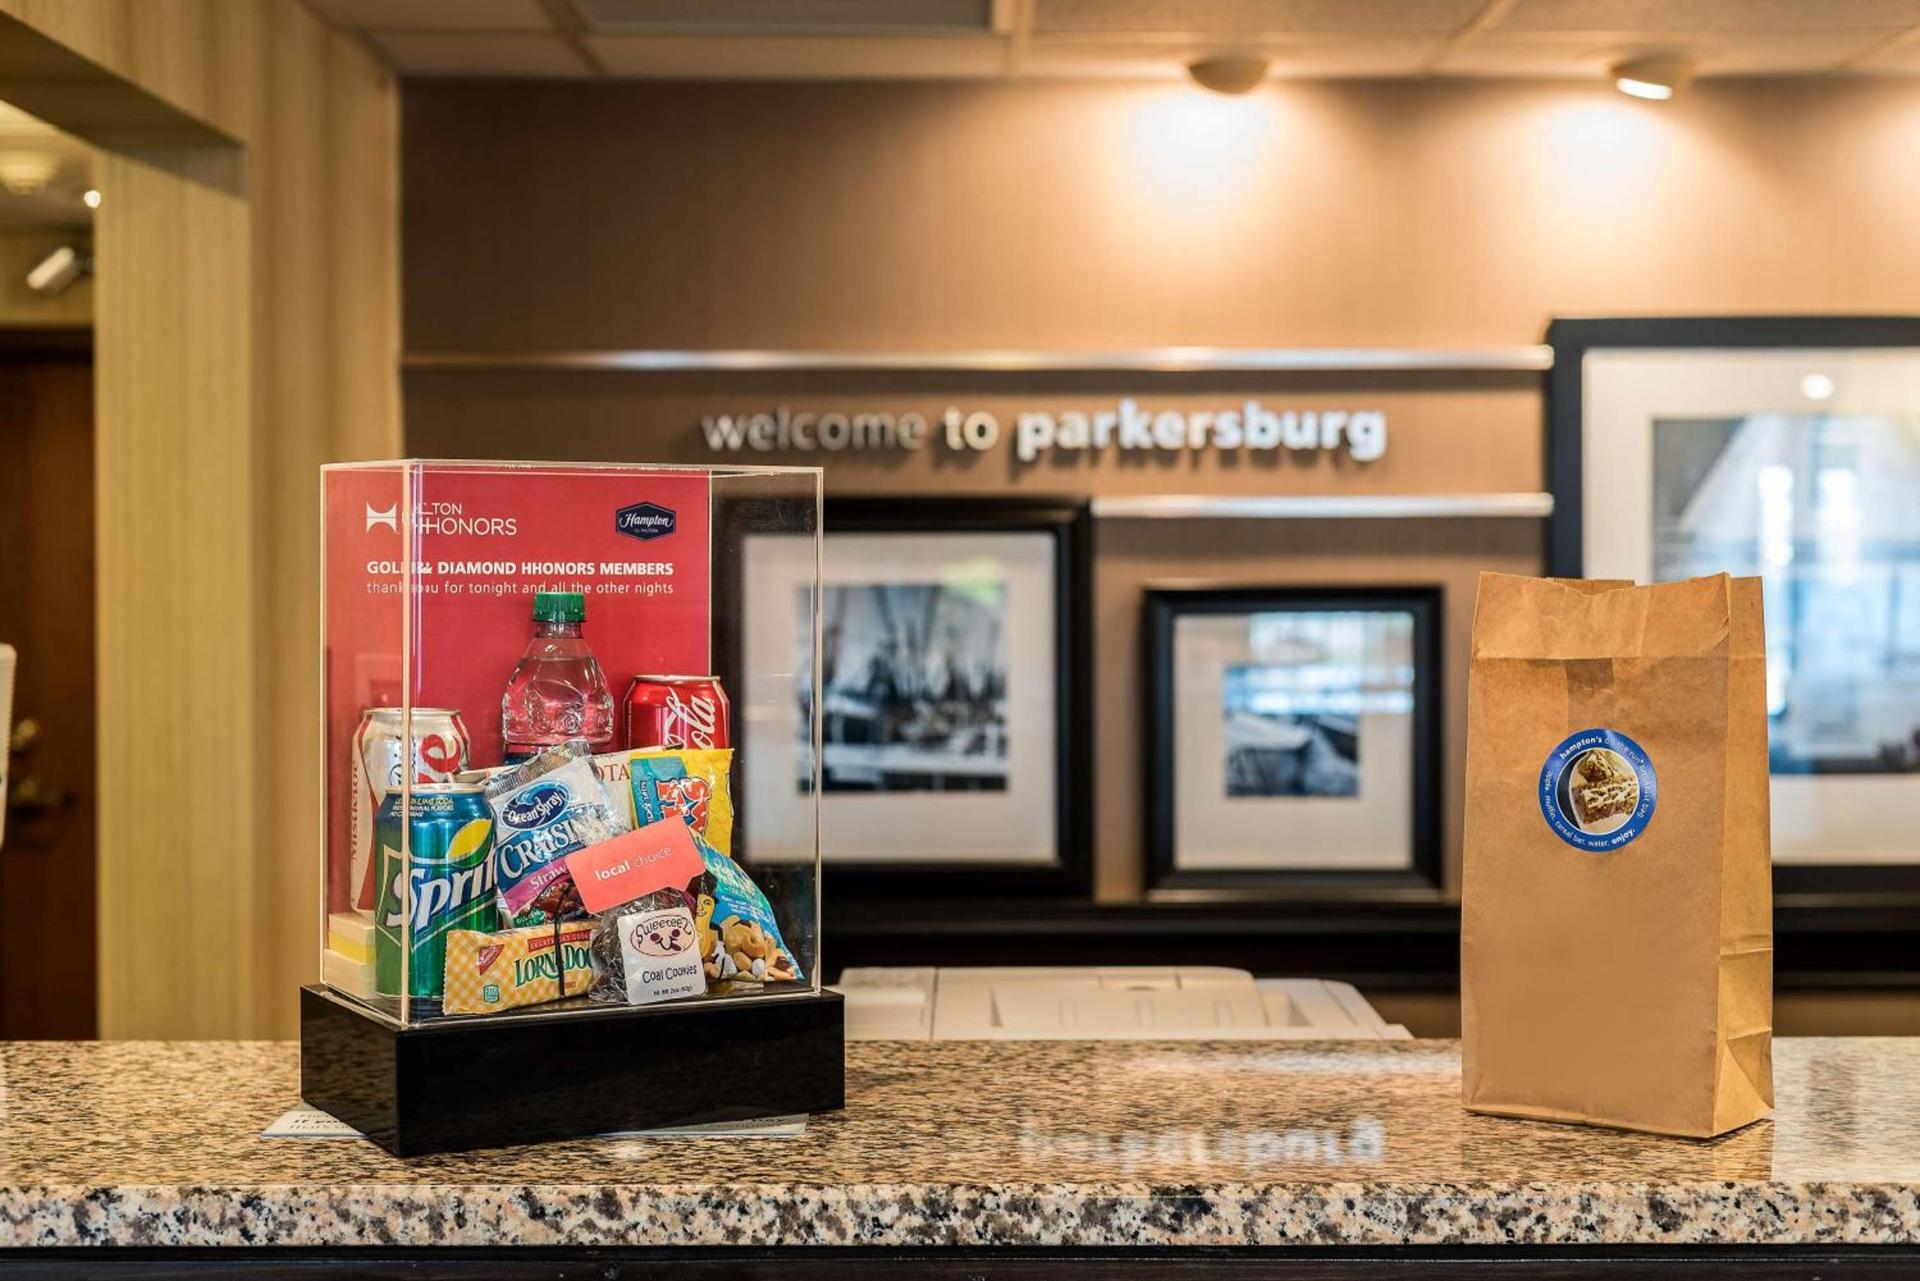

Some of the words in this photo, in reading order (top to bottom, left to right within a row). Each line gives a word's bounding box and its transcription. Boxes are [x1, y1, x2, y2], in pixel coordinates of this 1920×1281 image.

[703, 405, 927, 451] welcome
[943, 407, 999, 450] to
[1016, 397, 1389, 462] parkersburg
[618, 513, 674, 527] Hampton
[438, 561, 516, 574] DIAMOND
[521, 562, 595, 575] HHONORS
[599, 562, 674, 575] MEMBERS
[444, 581, 463, 593] for
[469, 582, 517, 596] tonight
[522, 582, 546, 593] and
[552, 582, 566, 592] all
[571, 583, 591, 593] the
[595, 582, 630, 594] other
[635, 582, 674, 596] nights
[1559, 736, 1603, 760] hampton's
[507, 808, 539, 824] Ocean
[537, 792, 563, 817] Spray
[1611, 828, 1636, 846] enjoy.
[594, 860, 631, 881] local
[633, 846, 673, 868] choice
[513, 950, 560, 988] LORN
[642, 970, 664, 984] Coal
[665, 964, 698, 981] Cookies
